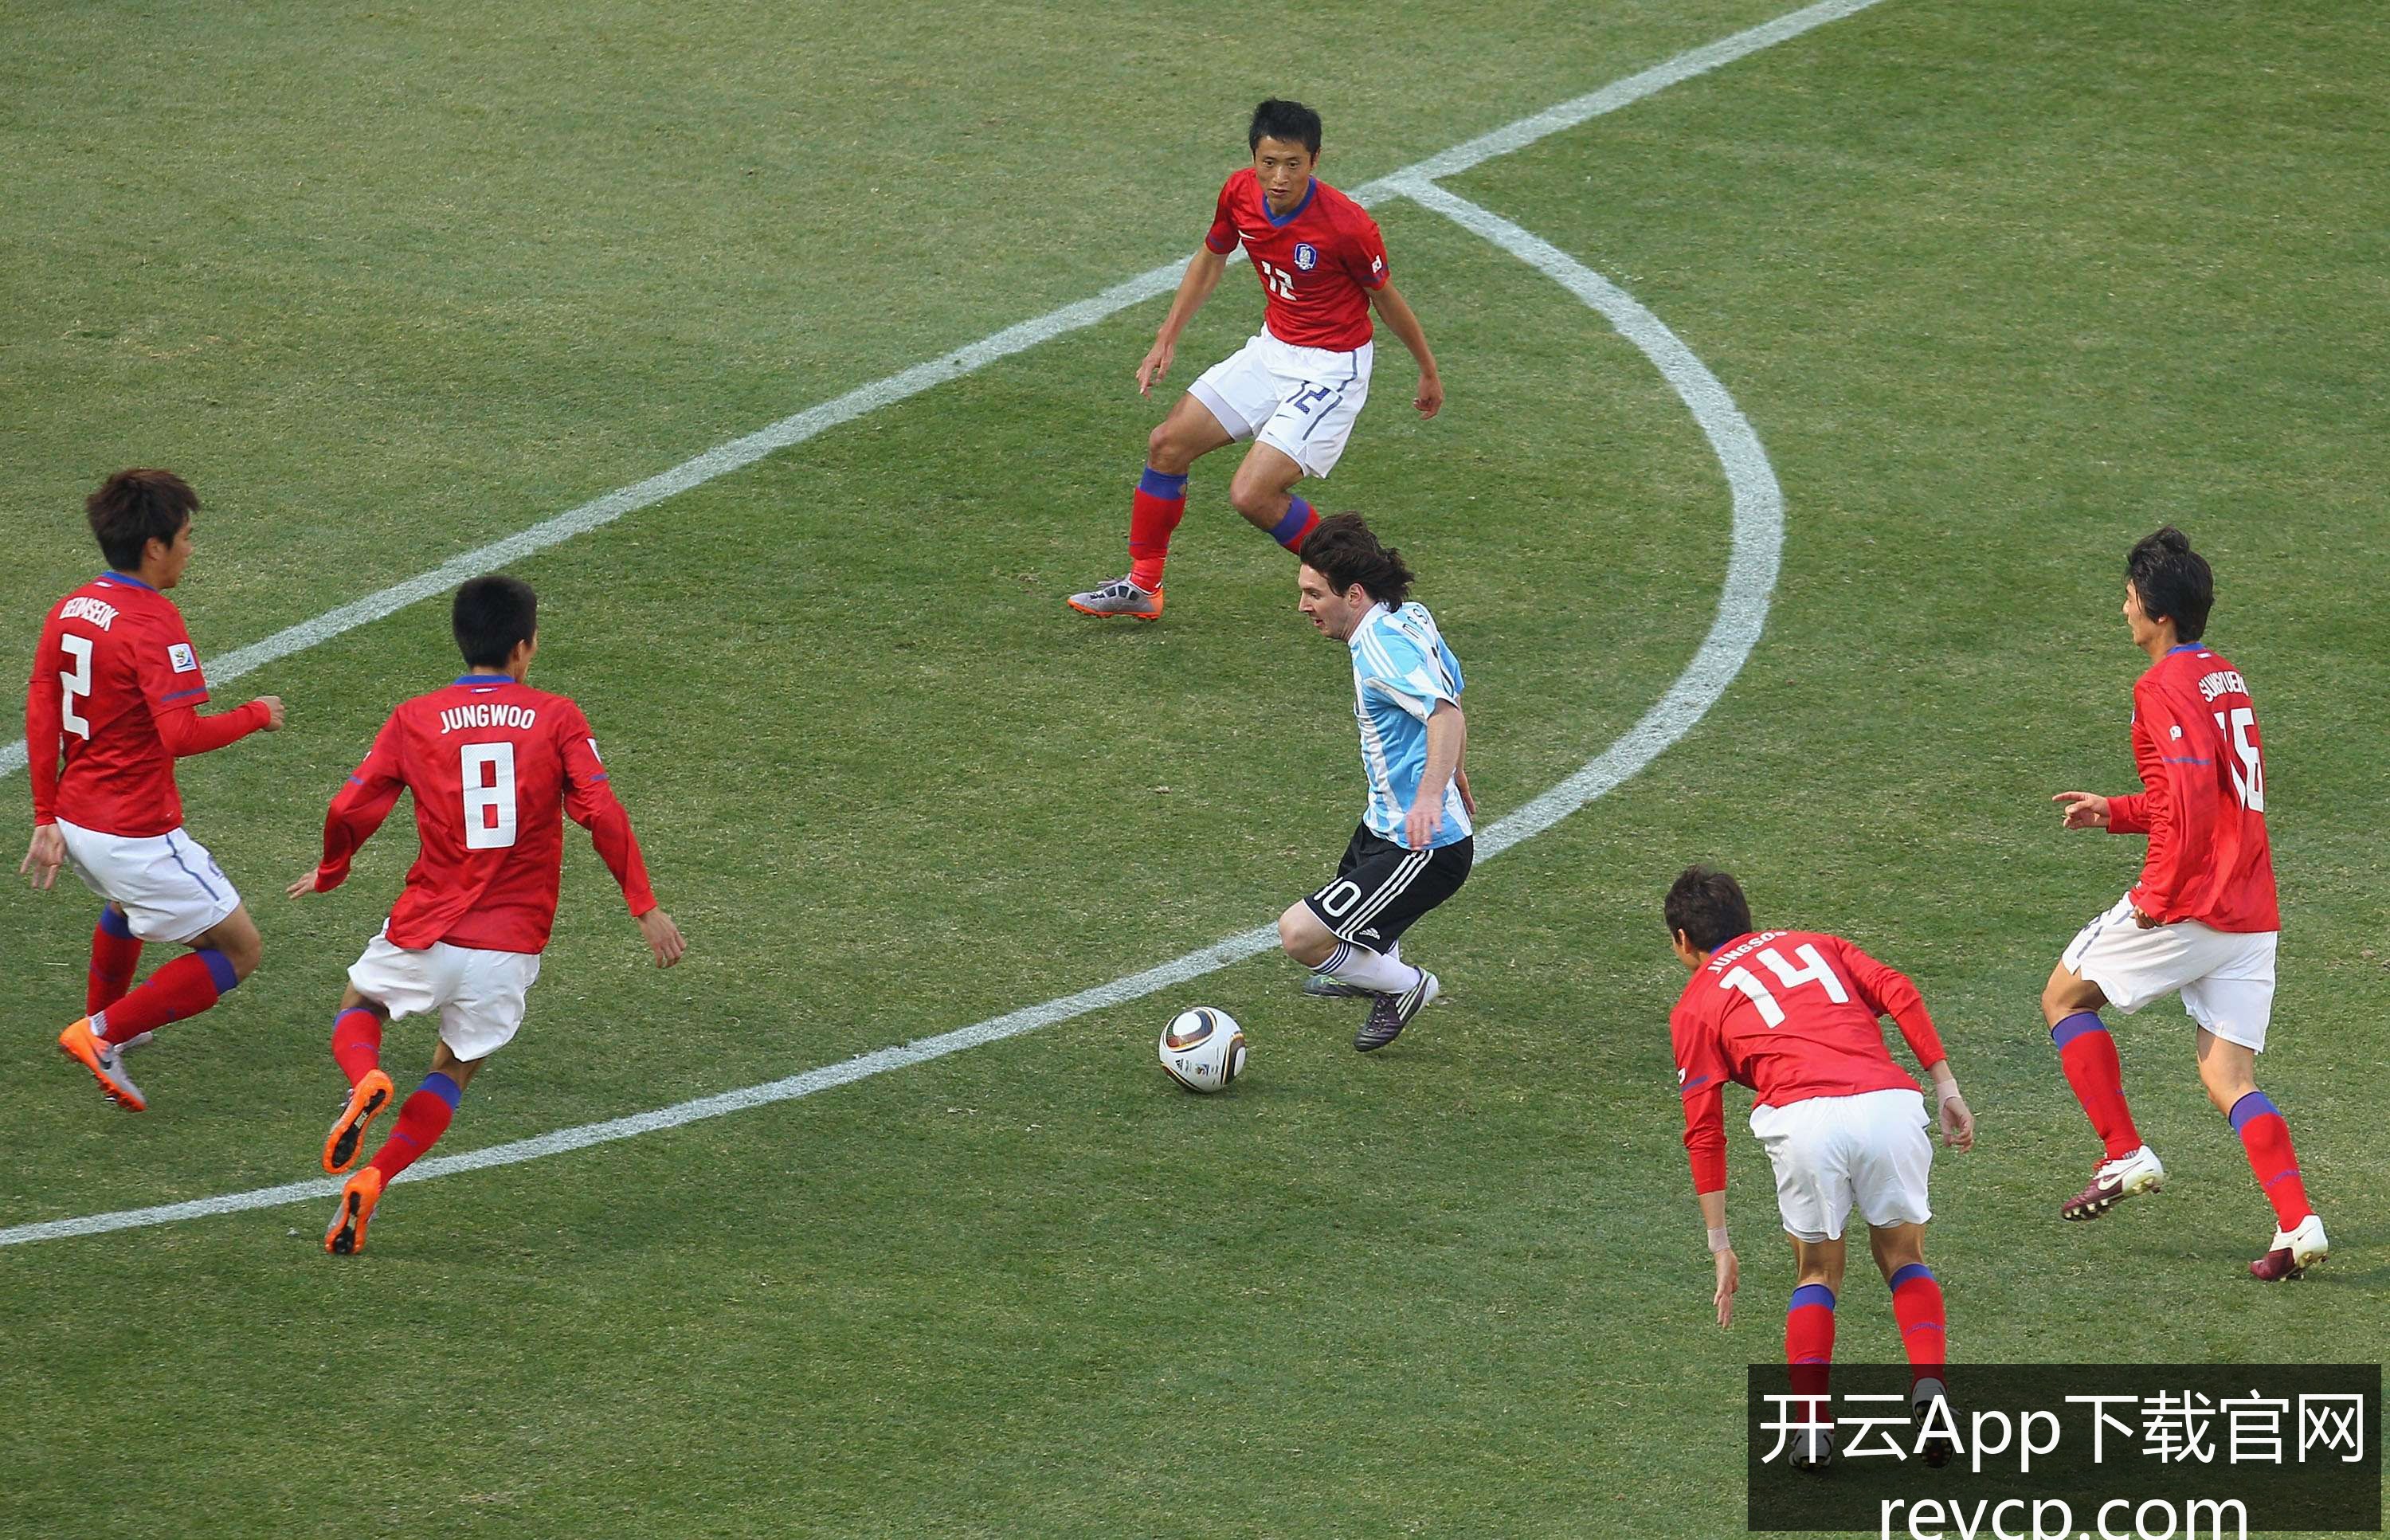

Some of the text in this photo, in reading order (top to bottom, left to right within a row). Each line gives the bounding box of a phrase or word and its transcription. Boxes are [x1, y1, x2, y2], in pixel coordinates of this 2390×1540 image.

[1261, 261, 1297, 301] 12
[1286, 380, 1331, 415] 12
[60, 633, 93, 741] 2
[440, 703, 536, 735] JUNGWOO
[2213, 707, 2264, 813] 16
[460, 742, 517, 850] 8
[1313, 876, 1362, 918] 10
[1718, 942, 1850, 1029] 14
